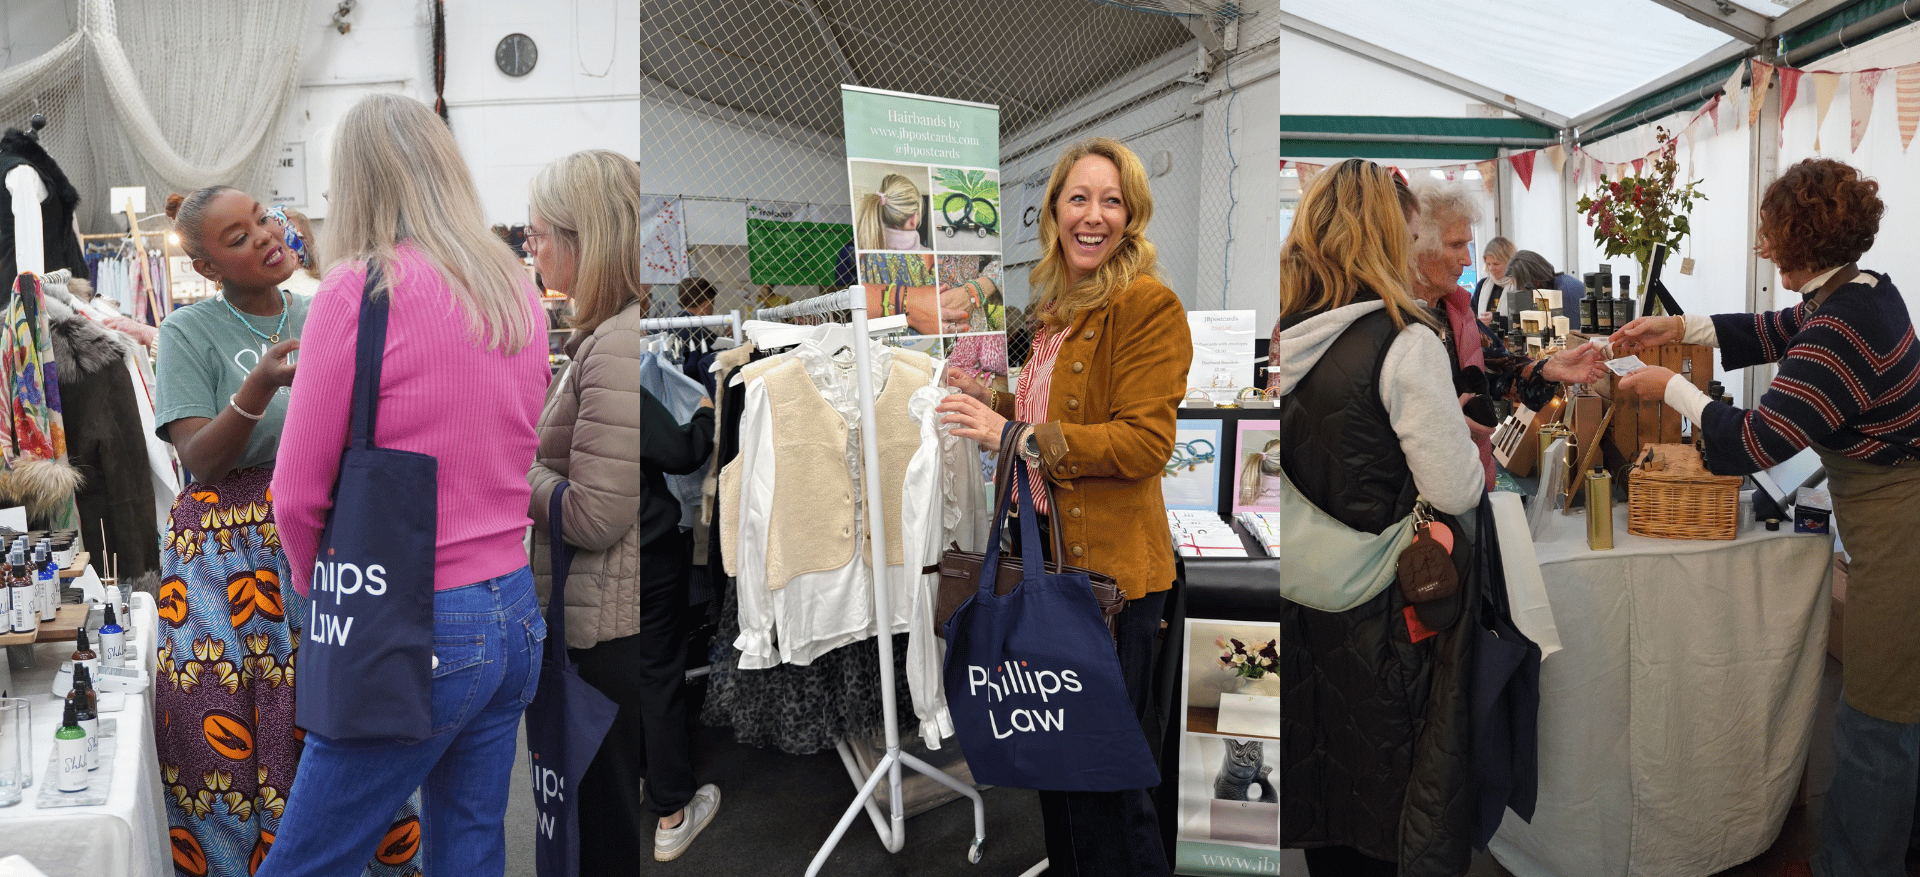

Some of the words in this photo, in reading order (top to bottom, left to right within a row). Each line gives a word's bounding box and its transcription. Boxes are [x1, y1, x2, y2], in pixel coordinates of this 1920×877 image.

[888, 110, 946, 127] Hairbands
[949, 116, 962, 131] by
[870, 126, 979, 146] www.jbpostcards.com
[894, 143, 960, 159] @jbpostcards
[968, 660, 1083, 703] Phillips
[989, 708, 1064, 740] Law
